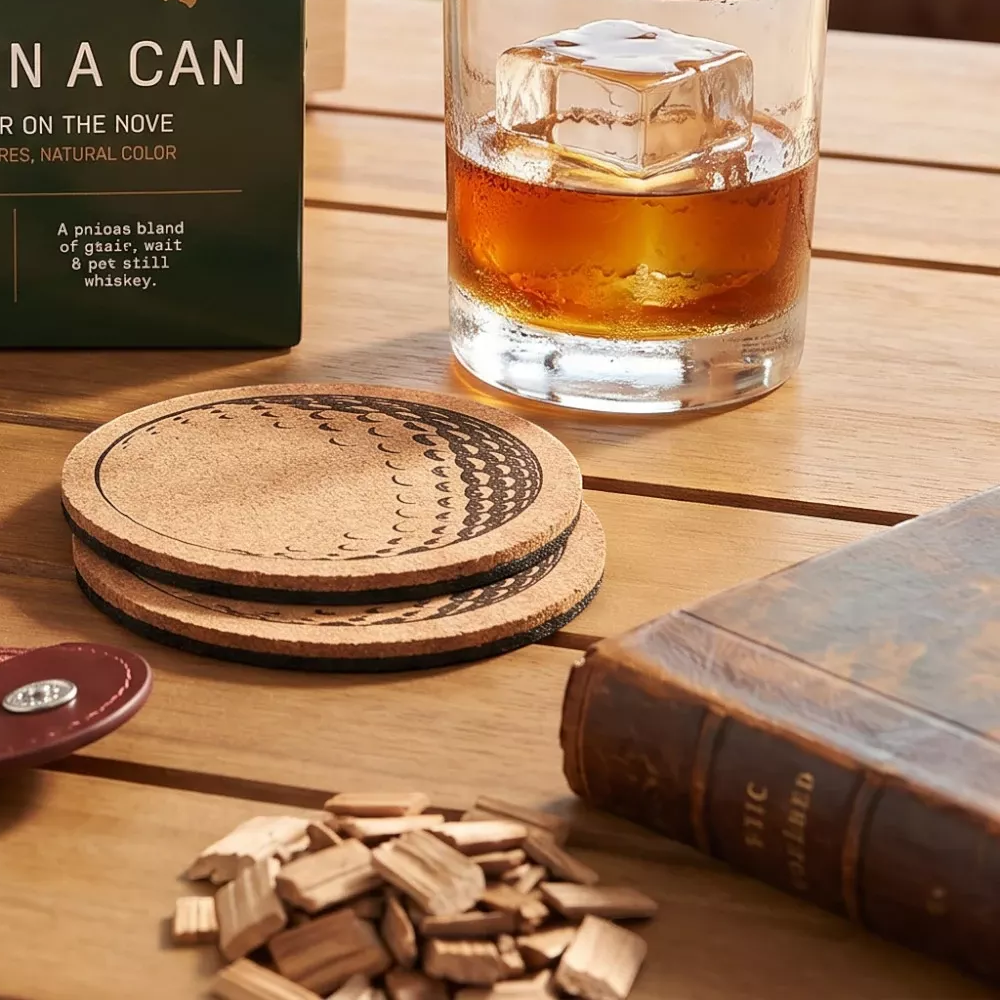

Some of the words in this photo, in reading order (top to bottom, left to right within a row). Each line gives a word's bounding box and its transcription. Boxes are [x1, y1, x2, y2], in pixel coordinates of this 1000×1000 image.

[66, 42, 103, 87] A
[129, 39, 245, 86] CAN
[23, 116, 53, 135] ON
[62, 115, 105, 134] THE
[115, 114, 173, 133] NOVE
[40, 146, 117, 162] NATURAL
[121, 145, 177, 161] COLOR
[57, 222, 68, 236] A
[137, 221, 184, 235] bland
[60, 240, 78, 253] of
[144, 238, 182, 251] wait
[123, 256, 169, 269] still
[84, 274, 157, 289] whiskey.
